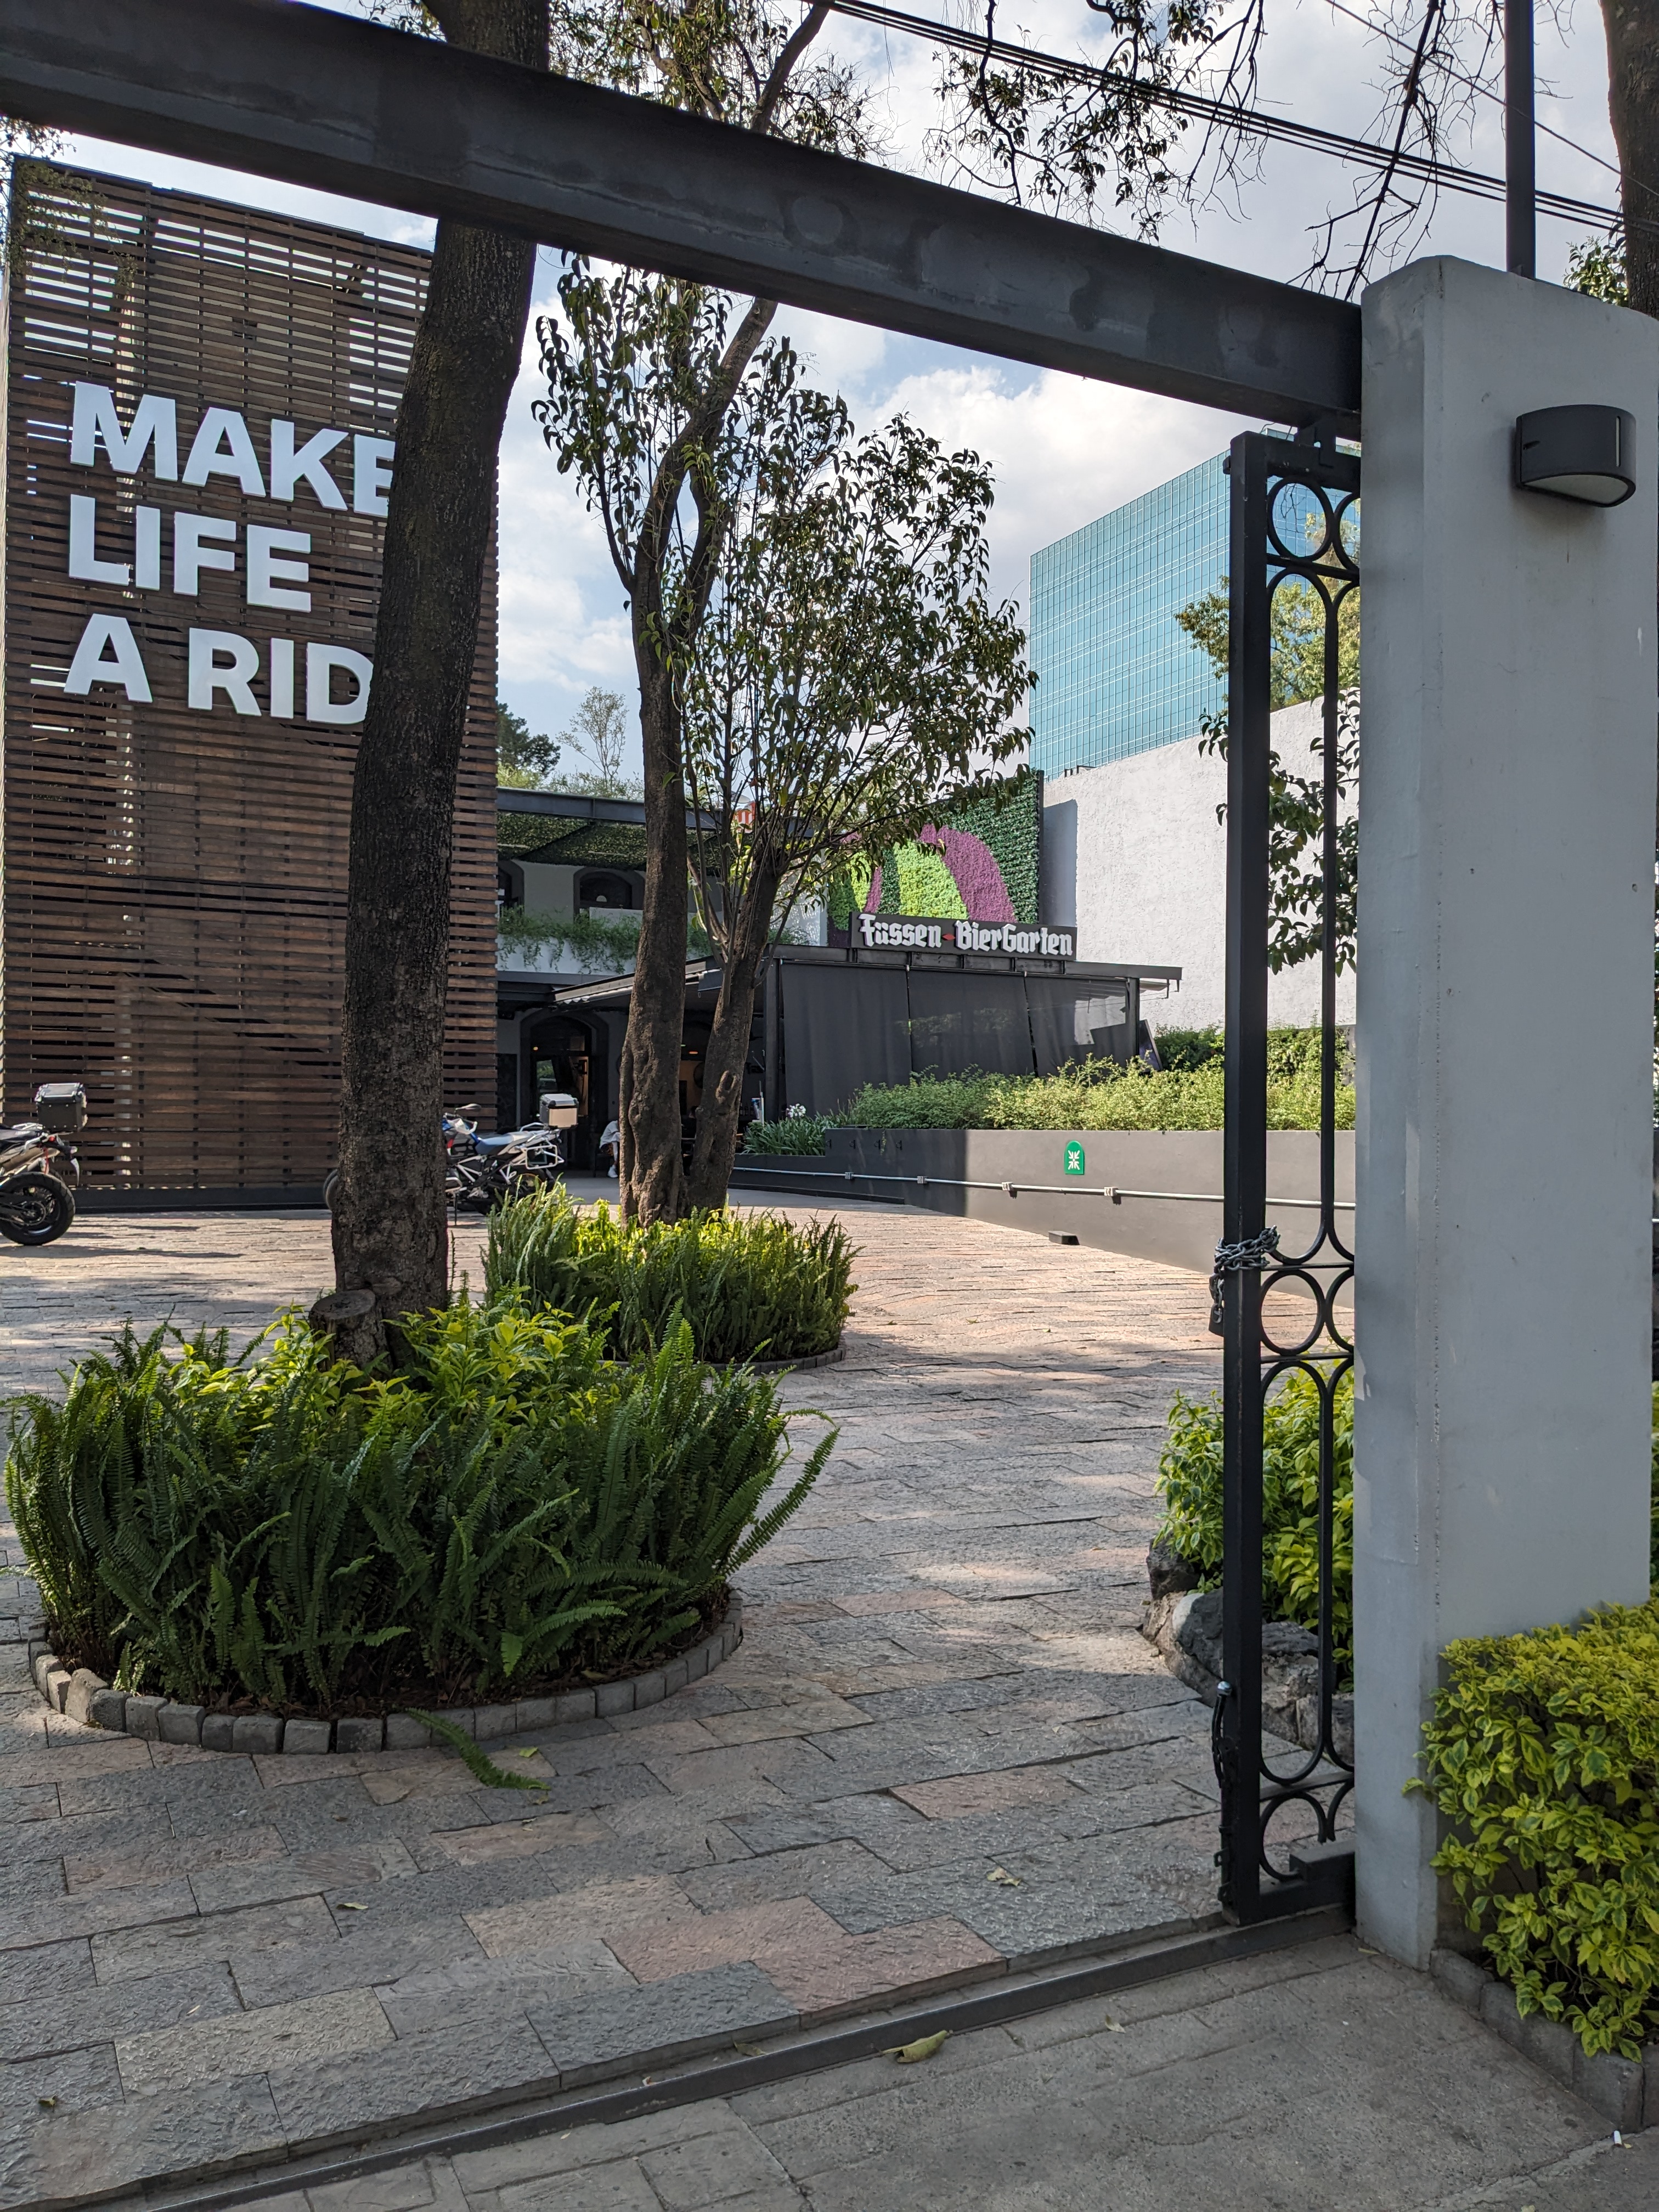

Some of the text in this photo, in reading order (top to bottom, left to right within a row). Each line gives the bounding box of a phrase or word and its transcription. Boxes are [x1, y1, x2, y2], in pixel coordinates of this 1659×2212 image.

[70, 381, 396, 517] MAKE
[69, 494, 311, 613] LIFE
[64, 613, 373, 724] A RID
[955, 919, 1073, 956] BierGarten
